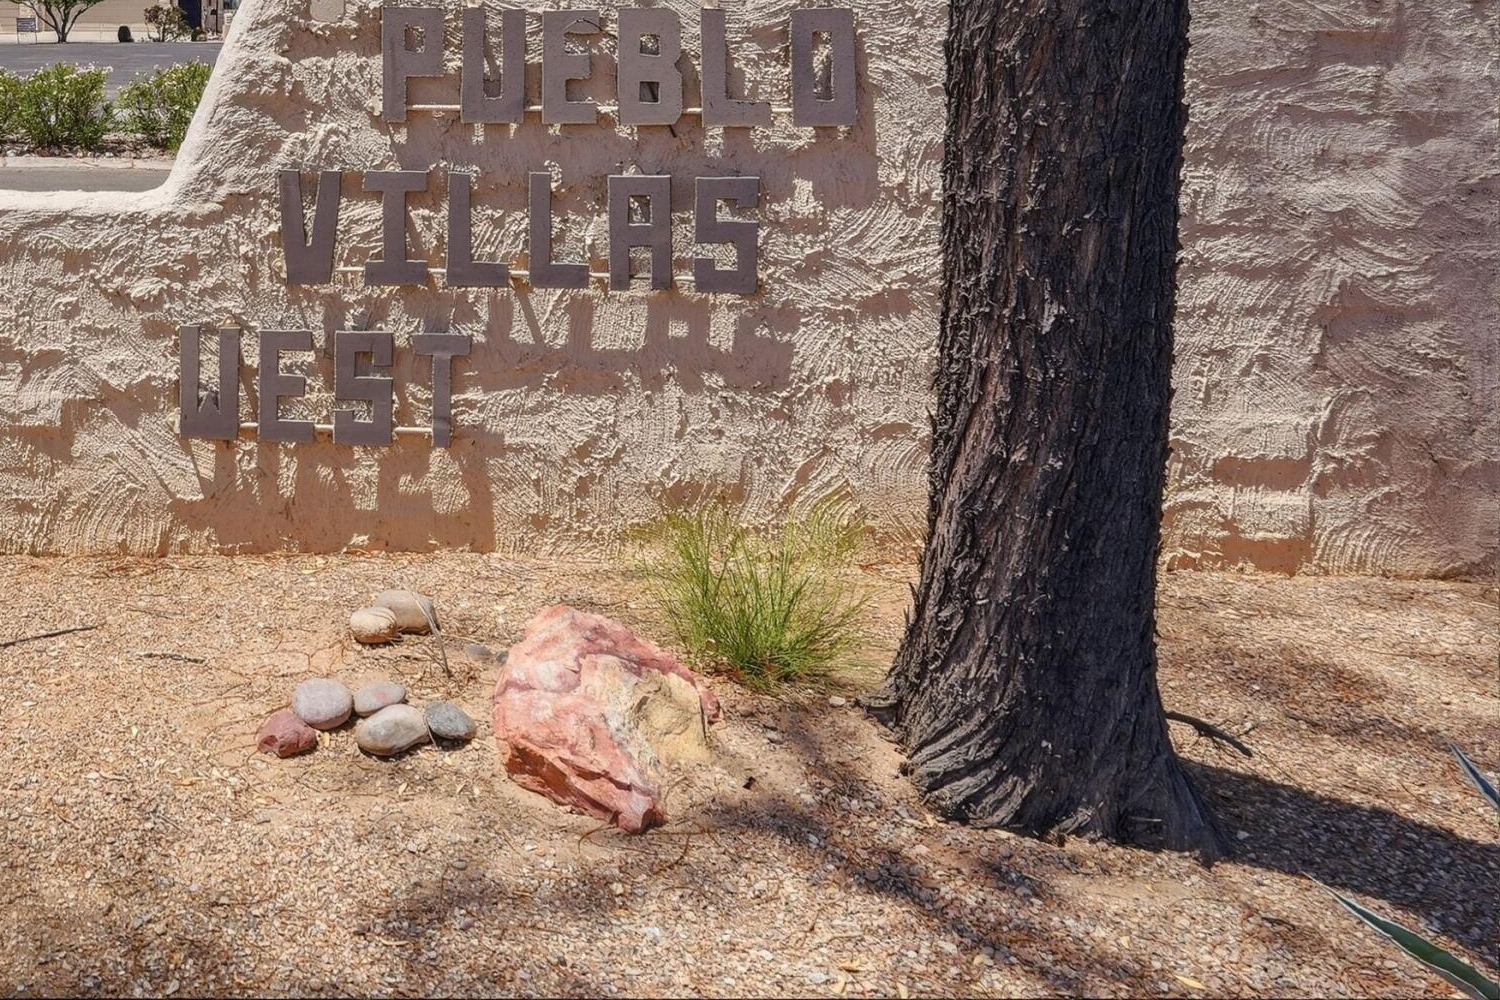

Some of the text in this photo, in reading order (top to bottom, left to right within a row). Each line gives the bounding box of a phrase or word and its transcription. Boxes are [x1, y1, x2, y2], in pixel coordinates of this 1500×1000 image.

[381, 6, 858, 127] PUEBLO
[279, 169, 761, 295] VILLAS
[179, 324, 471, 448] WEST
